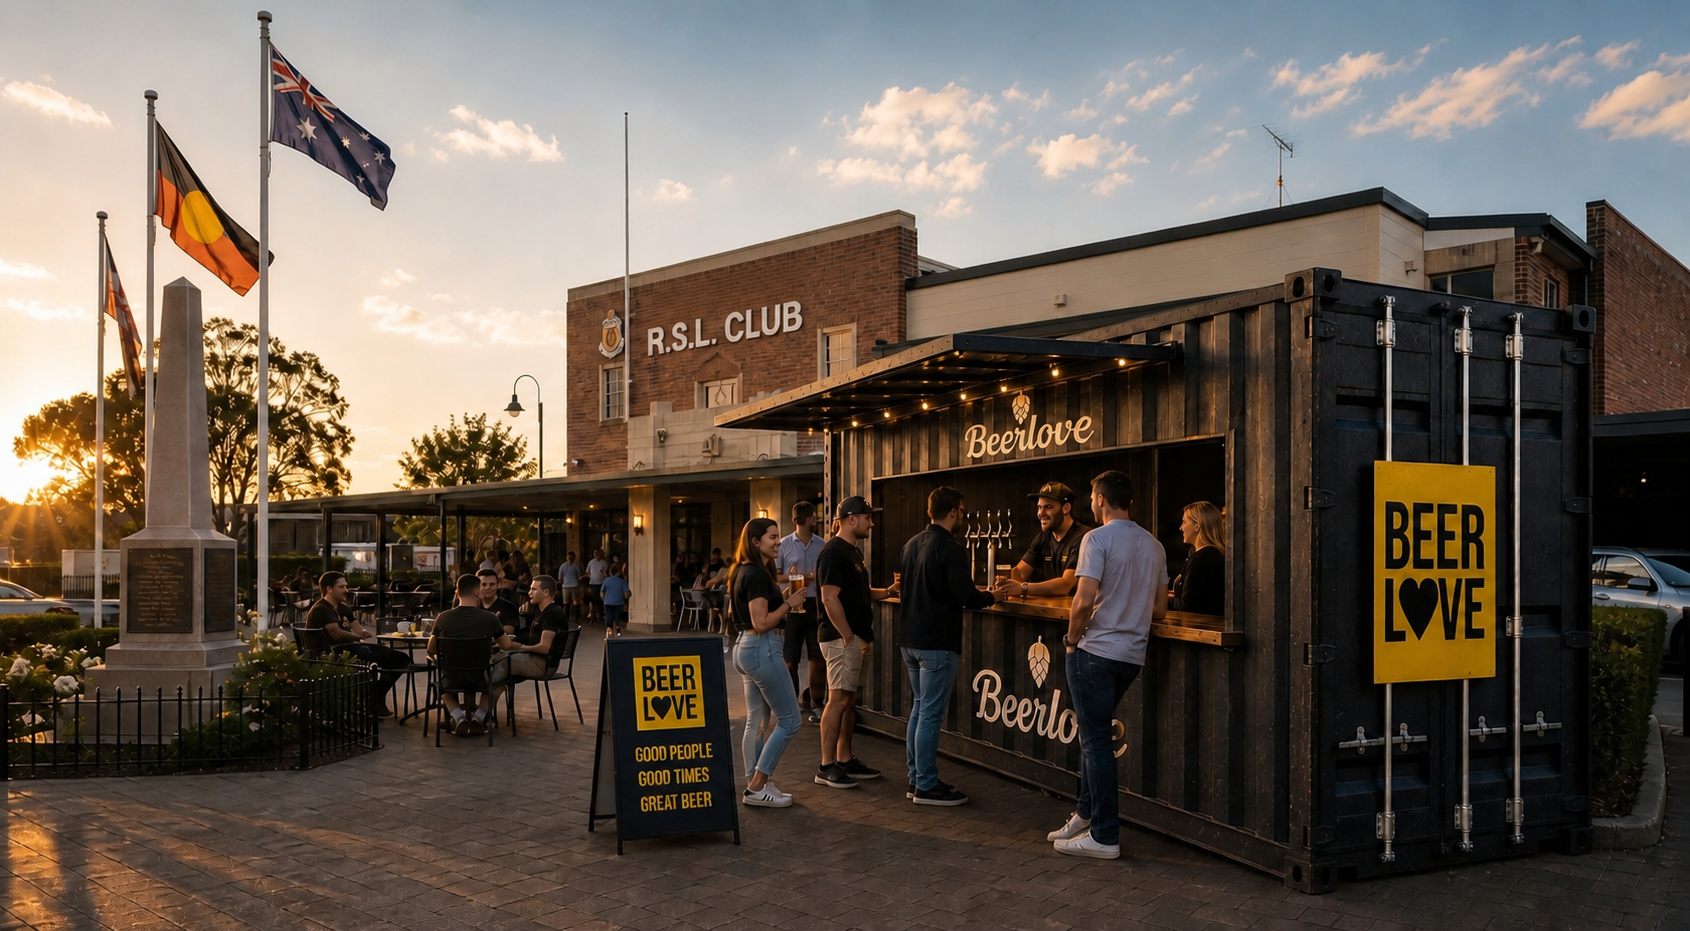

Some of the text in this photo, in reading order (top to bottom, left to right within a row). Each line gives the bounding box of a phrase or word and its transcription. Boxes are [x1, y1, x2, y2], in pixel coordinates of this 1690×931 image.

[647, 300, 803, 357] R.S.L. CLUB
[964, 414, 1096, 459] Beerlove
[1385, 501, 1485, 569] BEER
[641, 663, 696, 692] BEER
[972, 668, 1129, 759] Beerloe
[635, 742, 713, 763] GOOD PEOPLE
[638, 766, 710, 787] GOOD TIMES
[640, 791, 713, 813] GREAT BEER
